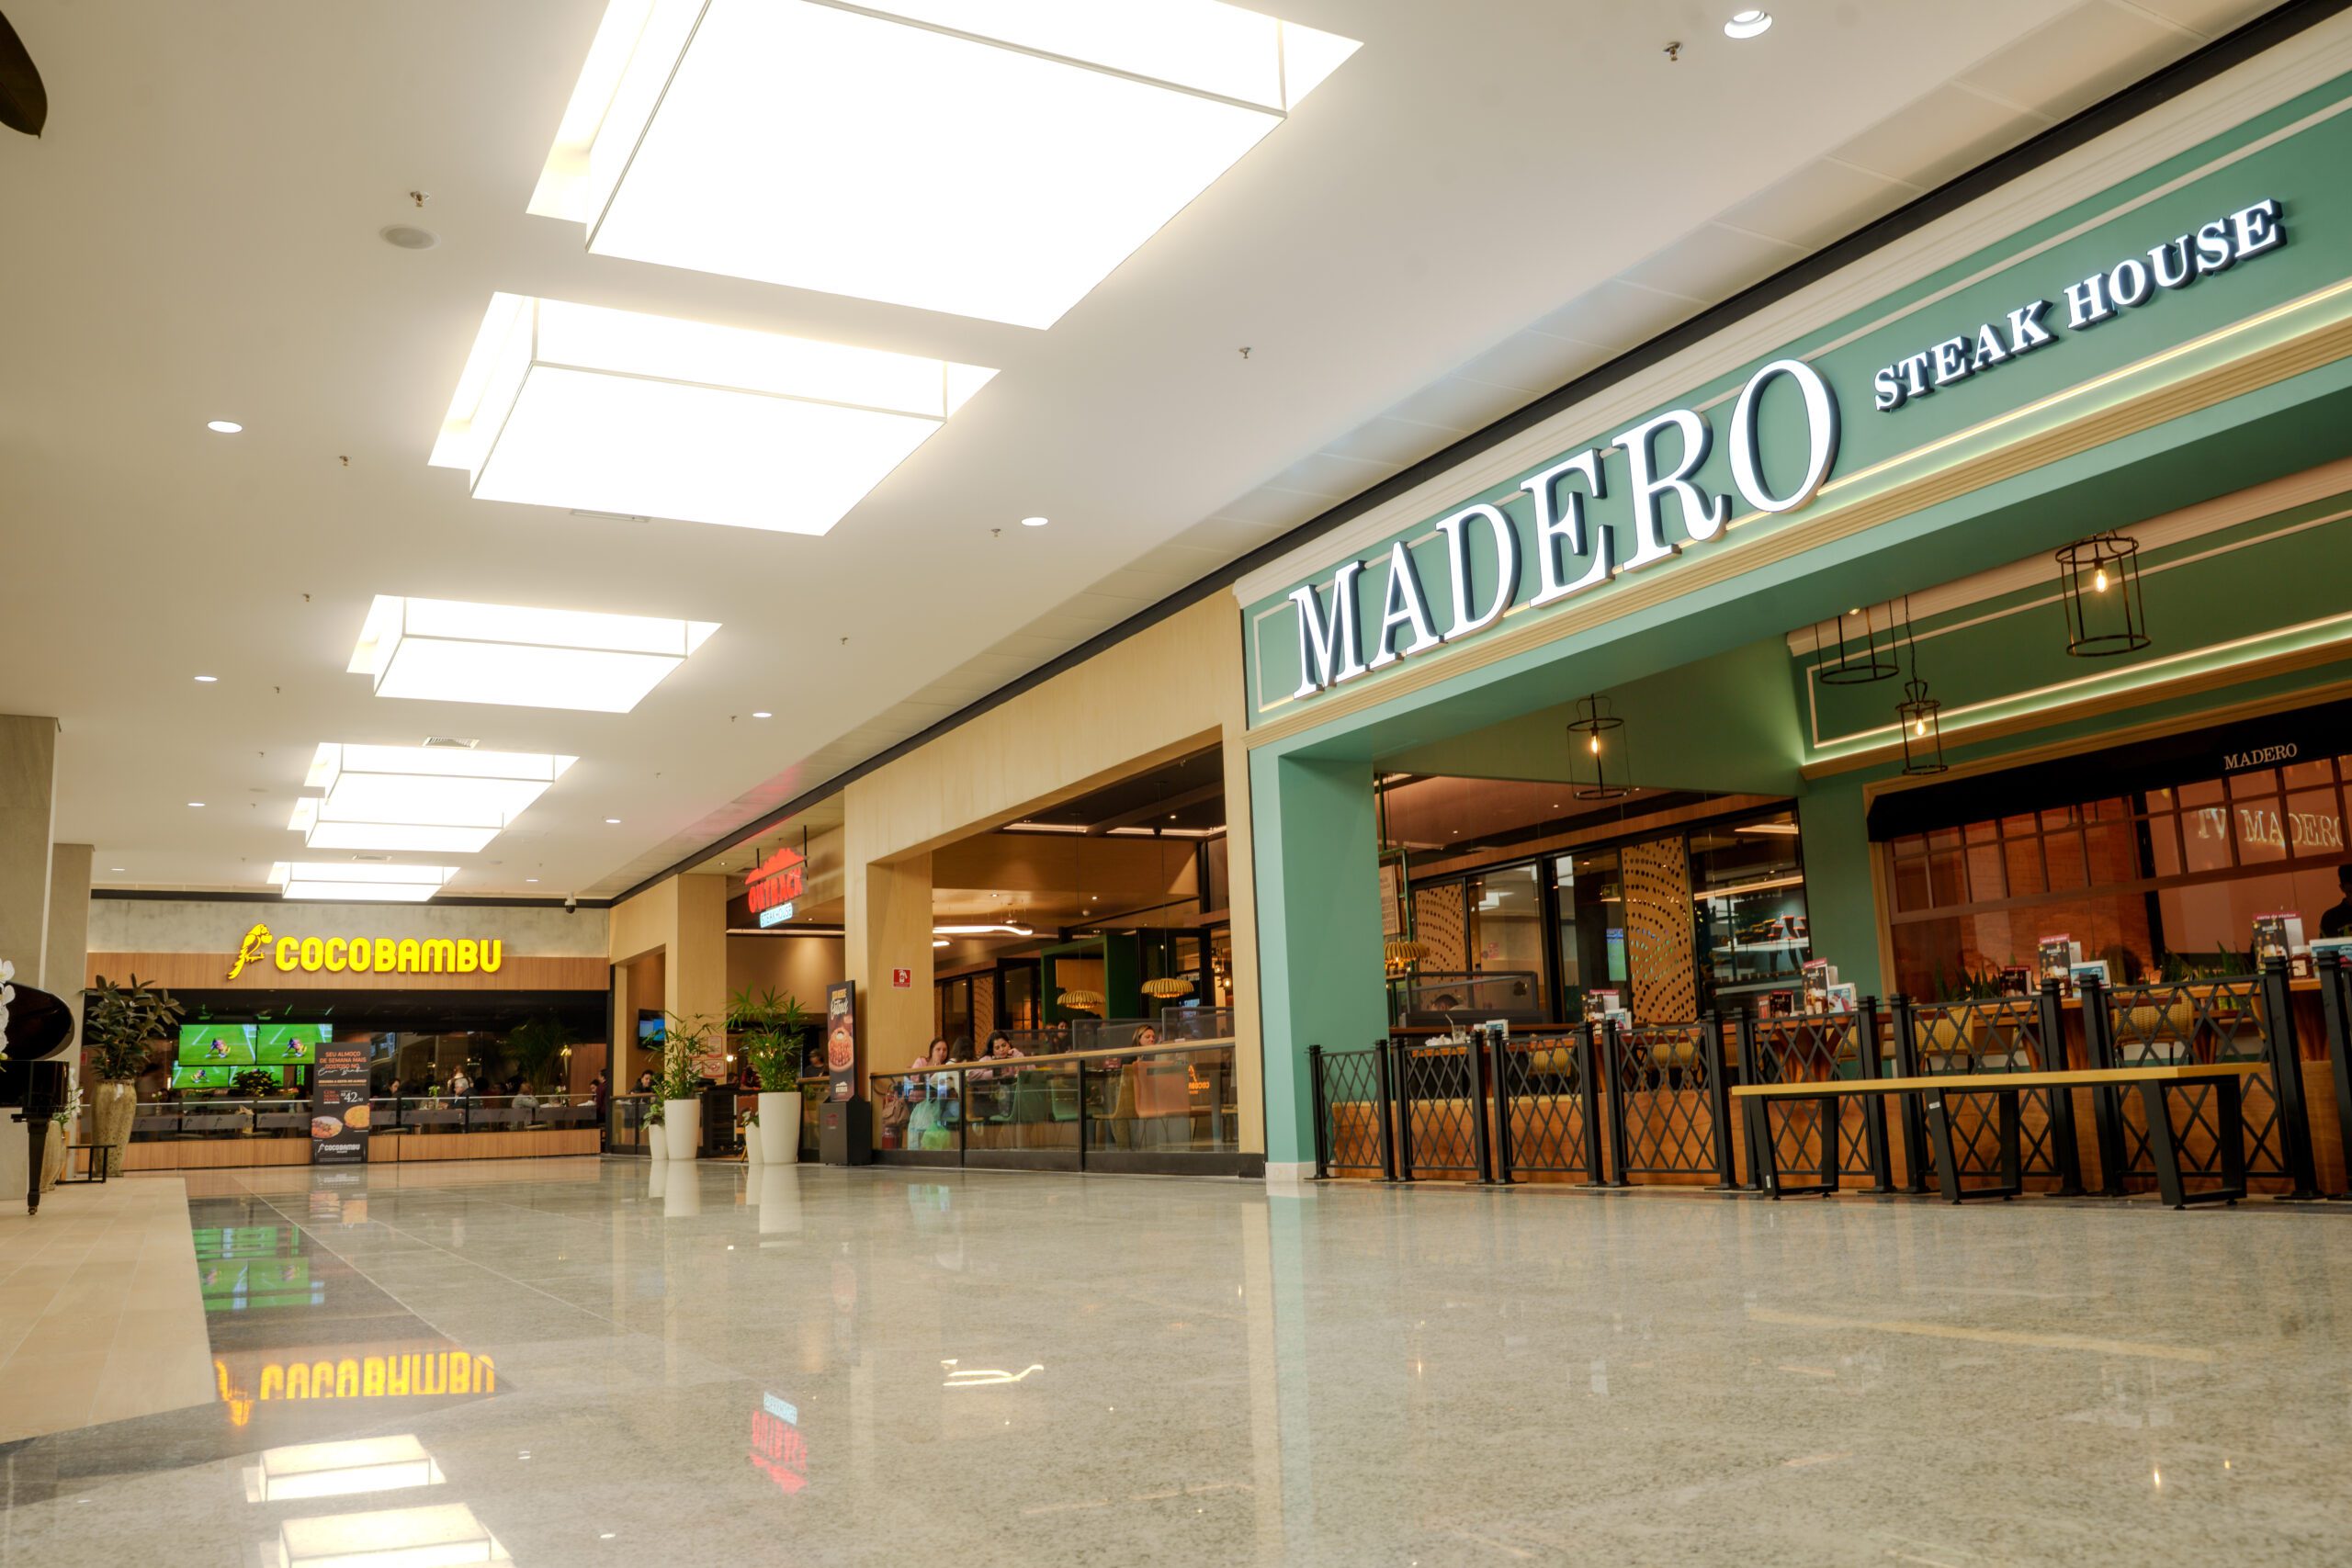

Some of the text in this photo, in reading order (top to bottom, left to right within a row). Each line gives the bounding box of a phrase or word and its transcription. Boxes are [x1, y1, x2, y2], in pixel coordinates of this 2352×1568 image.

[1874, 197, 2288, 413] STEAK HOUSE
[1288, 358, 1840, 701] MADERO
[2223, 743, 2298, 770] MADERO
[748, 866, 803, 914] OUTBACK
